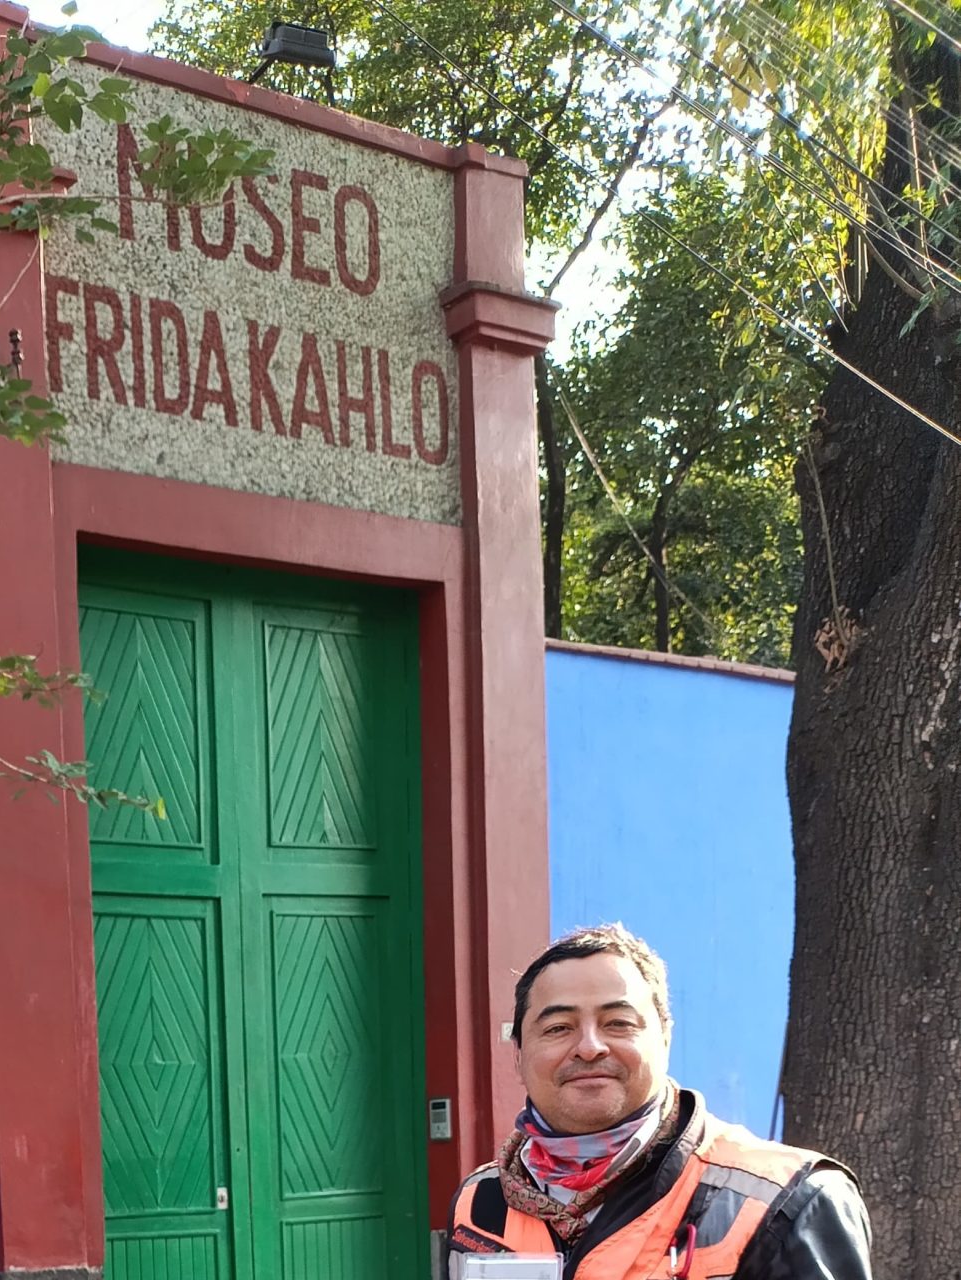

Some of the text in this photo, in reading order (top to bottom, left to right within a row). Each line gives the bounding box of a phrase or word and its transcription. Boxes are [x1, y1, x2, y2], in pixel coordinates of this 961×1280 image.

[117, 122, 380, 297] MUSEO
[45, 277, 449, 466] FRIDA KAHLO
